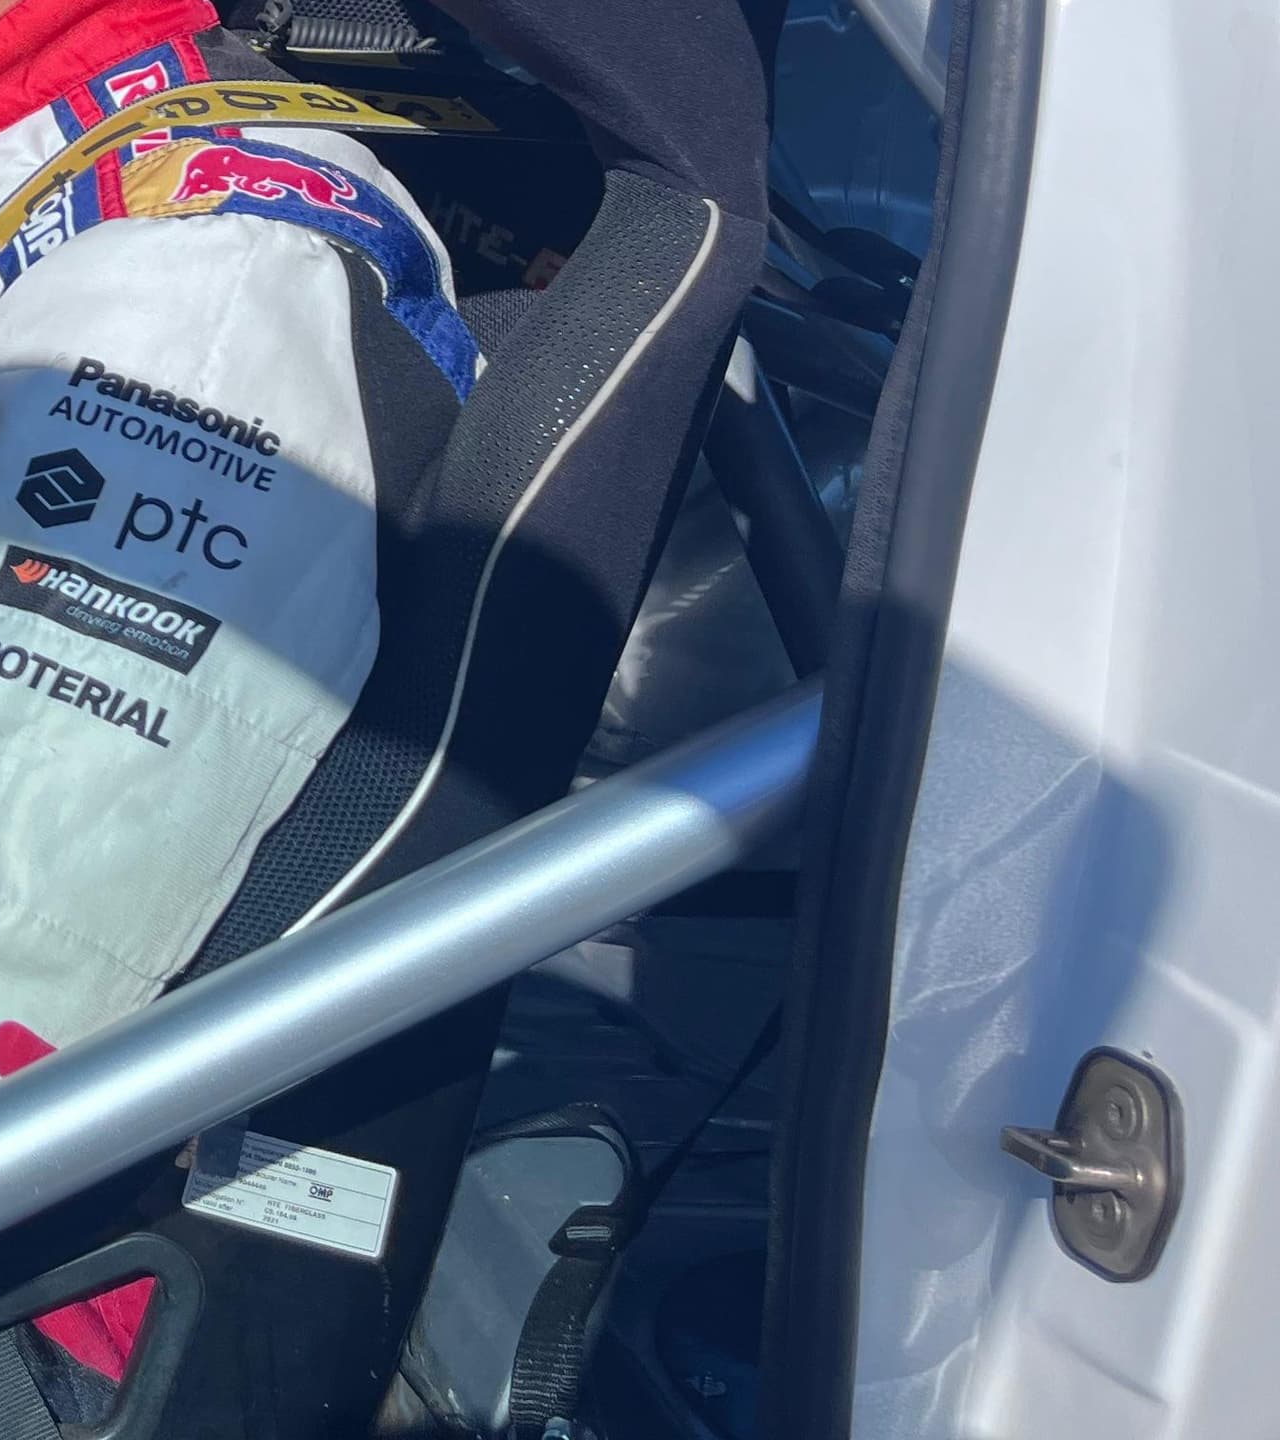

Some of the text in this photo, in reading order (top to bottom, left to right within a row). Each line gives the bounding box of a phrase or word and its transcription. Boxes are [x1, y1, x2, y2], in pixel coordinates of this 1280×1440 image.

[49, 394, 277, 493] AUTOMOTIVE
[68, 356, 281, 458] Panasonic
[114, 492, 248, 570] ptc
[308, 1184, 334, 1199] OMP
